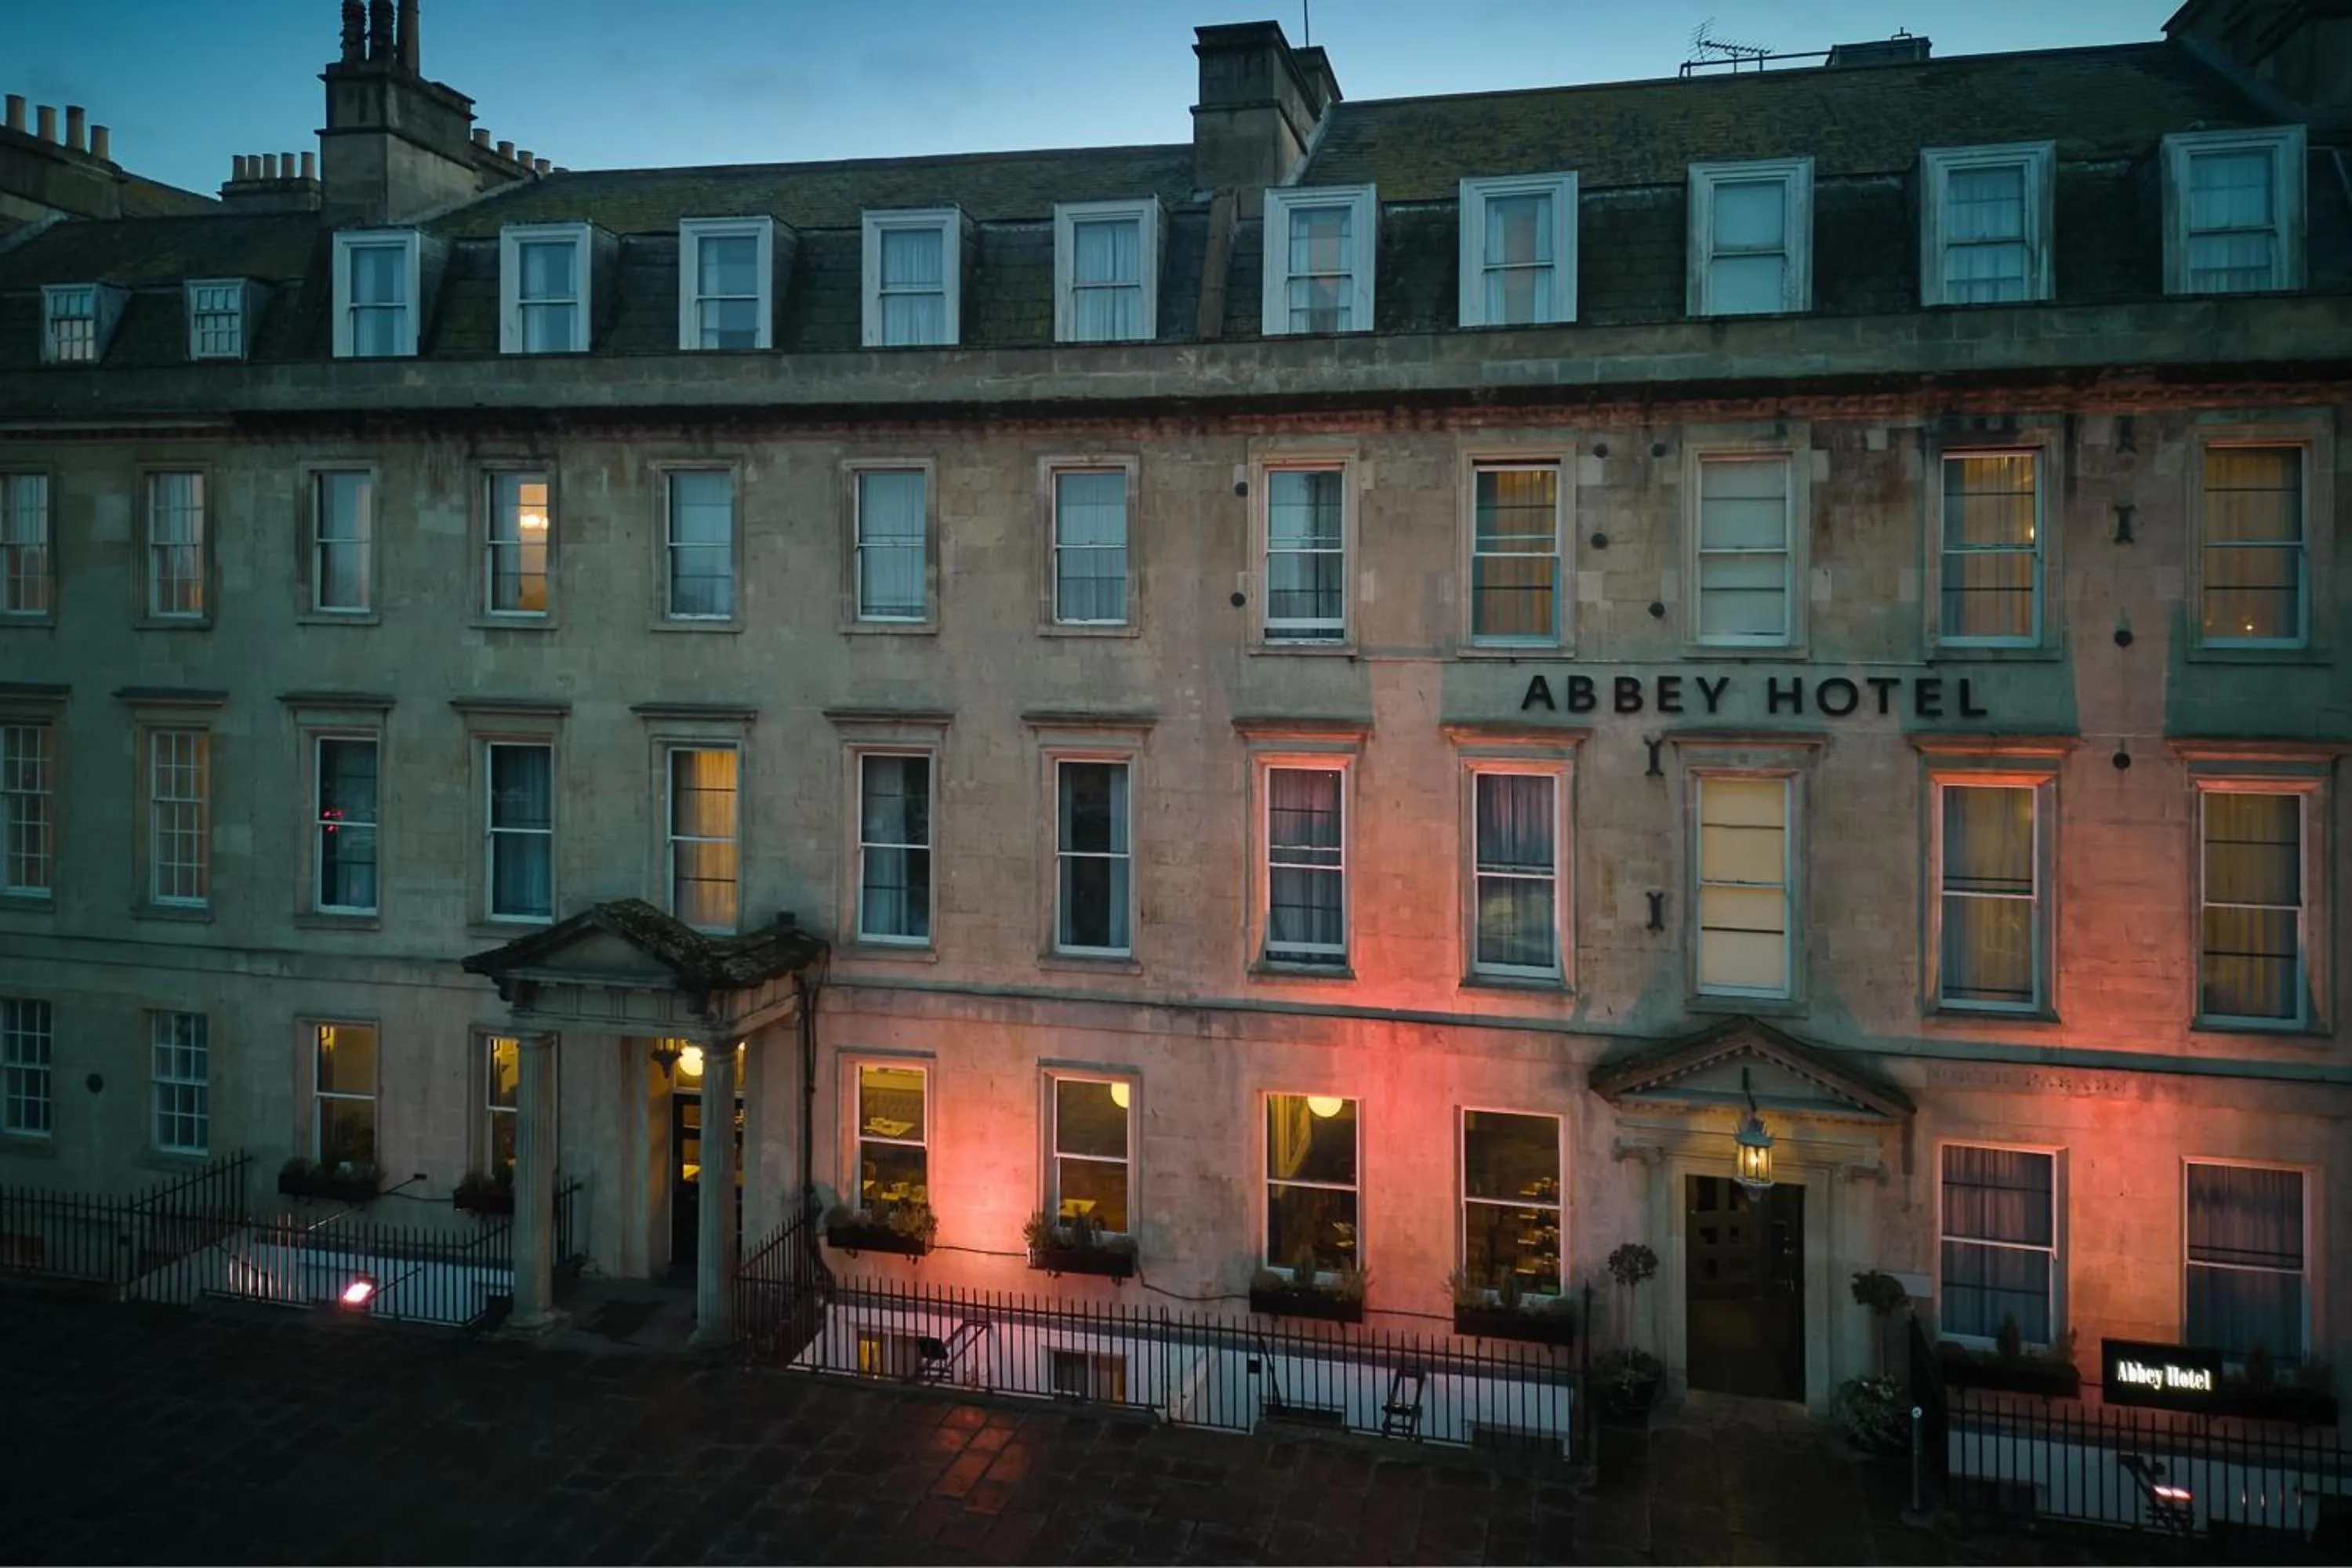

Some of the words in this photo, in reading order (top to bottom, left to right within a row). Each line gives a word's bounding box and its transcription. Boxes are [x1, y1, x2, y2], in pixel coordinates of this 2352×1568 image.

[1521, 675, 1730, 713] ABBEY
[1768, 677, 1987, 717] HOTEL
[2118, 1360, 2163, 1390] Abbey
[2165, 1365, 2212, 1391] Hotel
